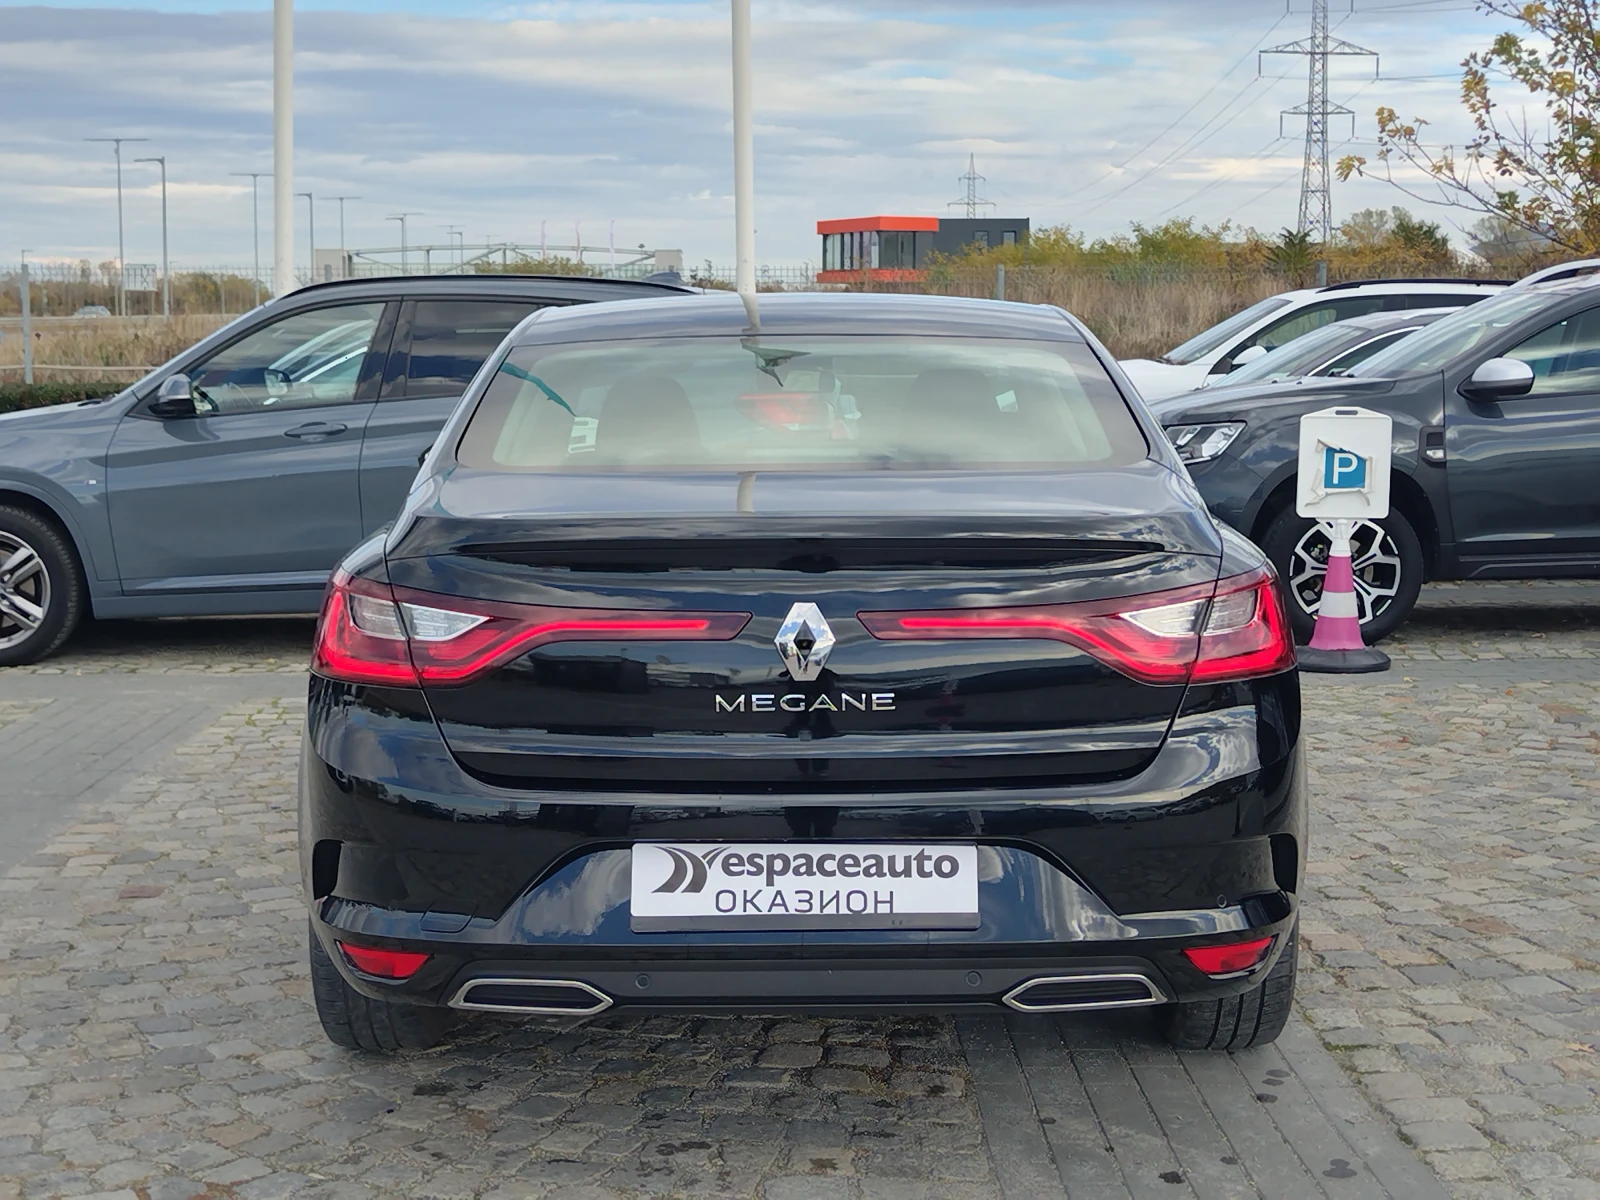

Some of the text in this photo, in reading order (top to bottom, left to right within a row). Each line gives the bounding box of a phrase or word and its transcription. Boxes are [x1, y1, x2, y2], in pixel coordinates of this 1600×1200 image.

[1332, 452, 1358, 485] P
[715, 692, 897, 713] MEGANE
[720, 847, 960, 887] espaceauto
[714, 889, 895, 915] ОКАЗИОН
